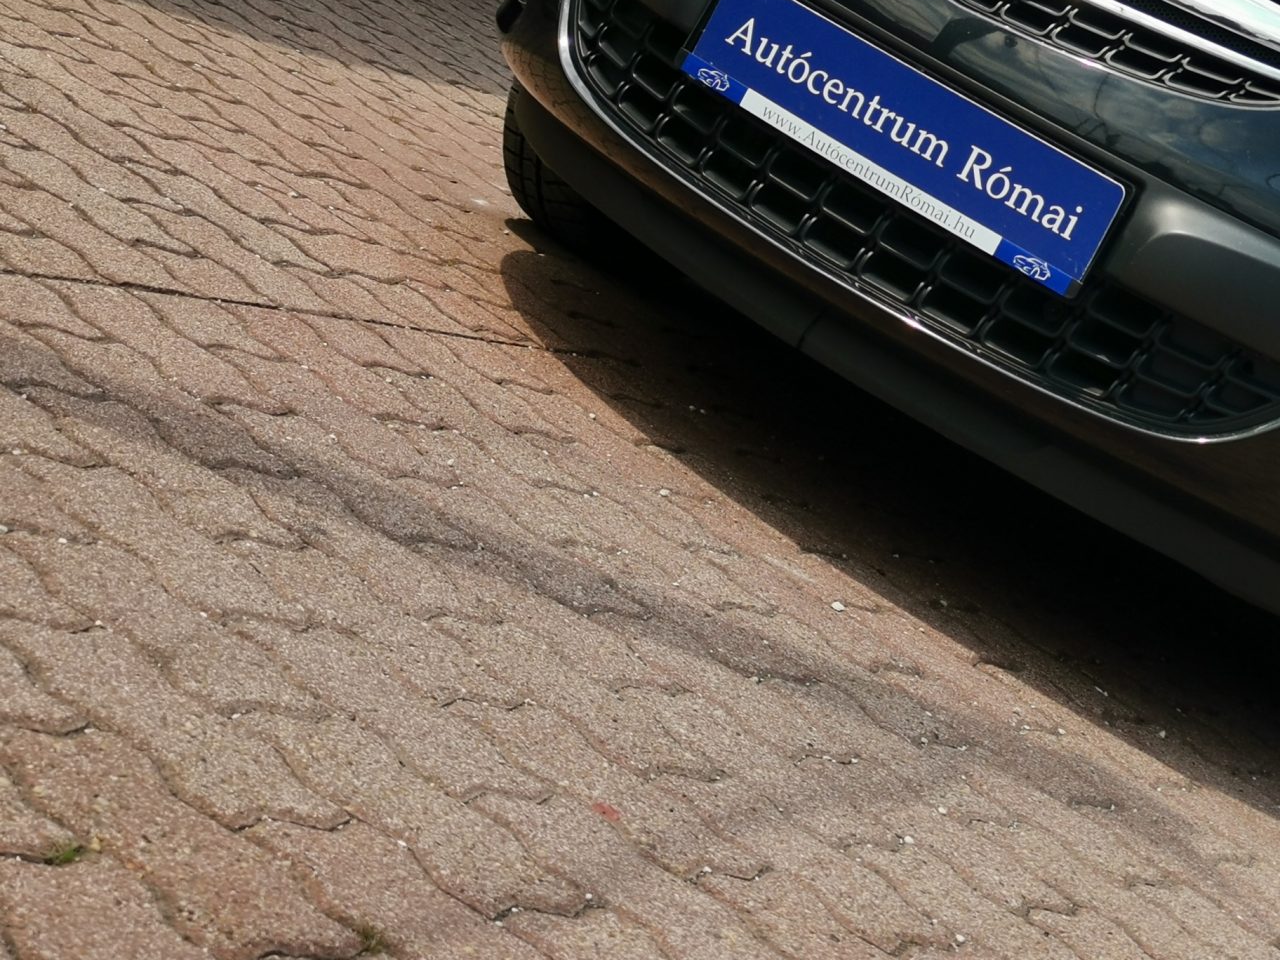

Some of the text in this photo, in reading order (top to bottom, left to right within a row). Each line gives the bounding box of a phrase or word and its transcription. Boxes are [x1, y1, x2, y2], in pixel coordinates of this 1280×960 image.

[724, 17, 1085, 242] Autócentrum Római
[762, 104, 976, 240] www.AutócentrumRómai.hu
